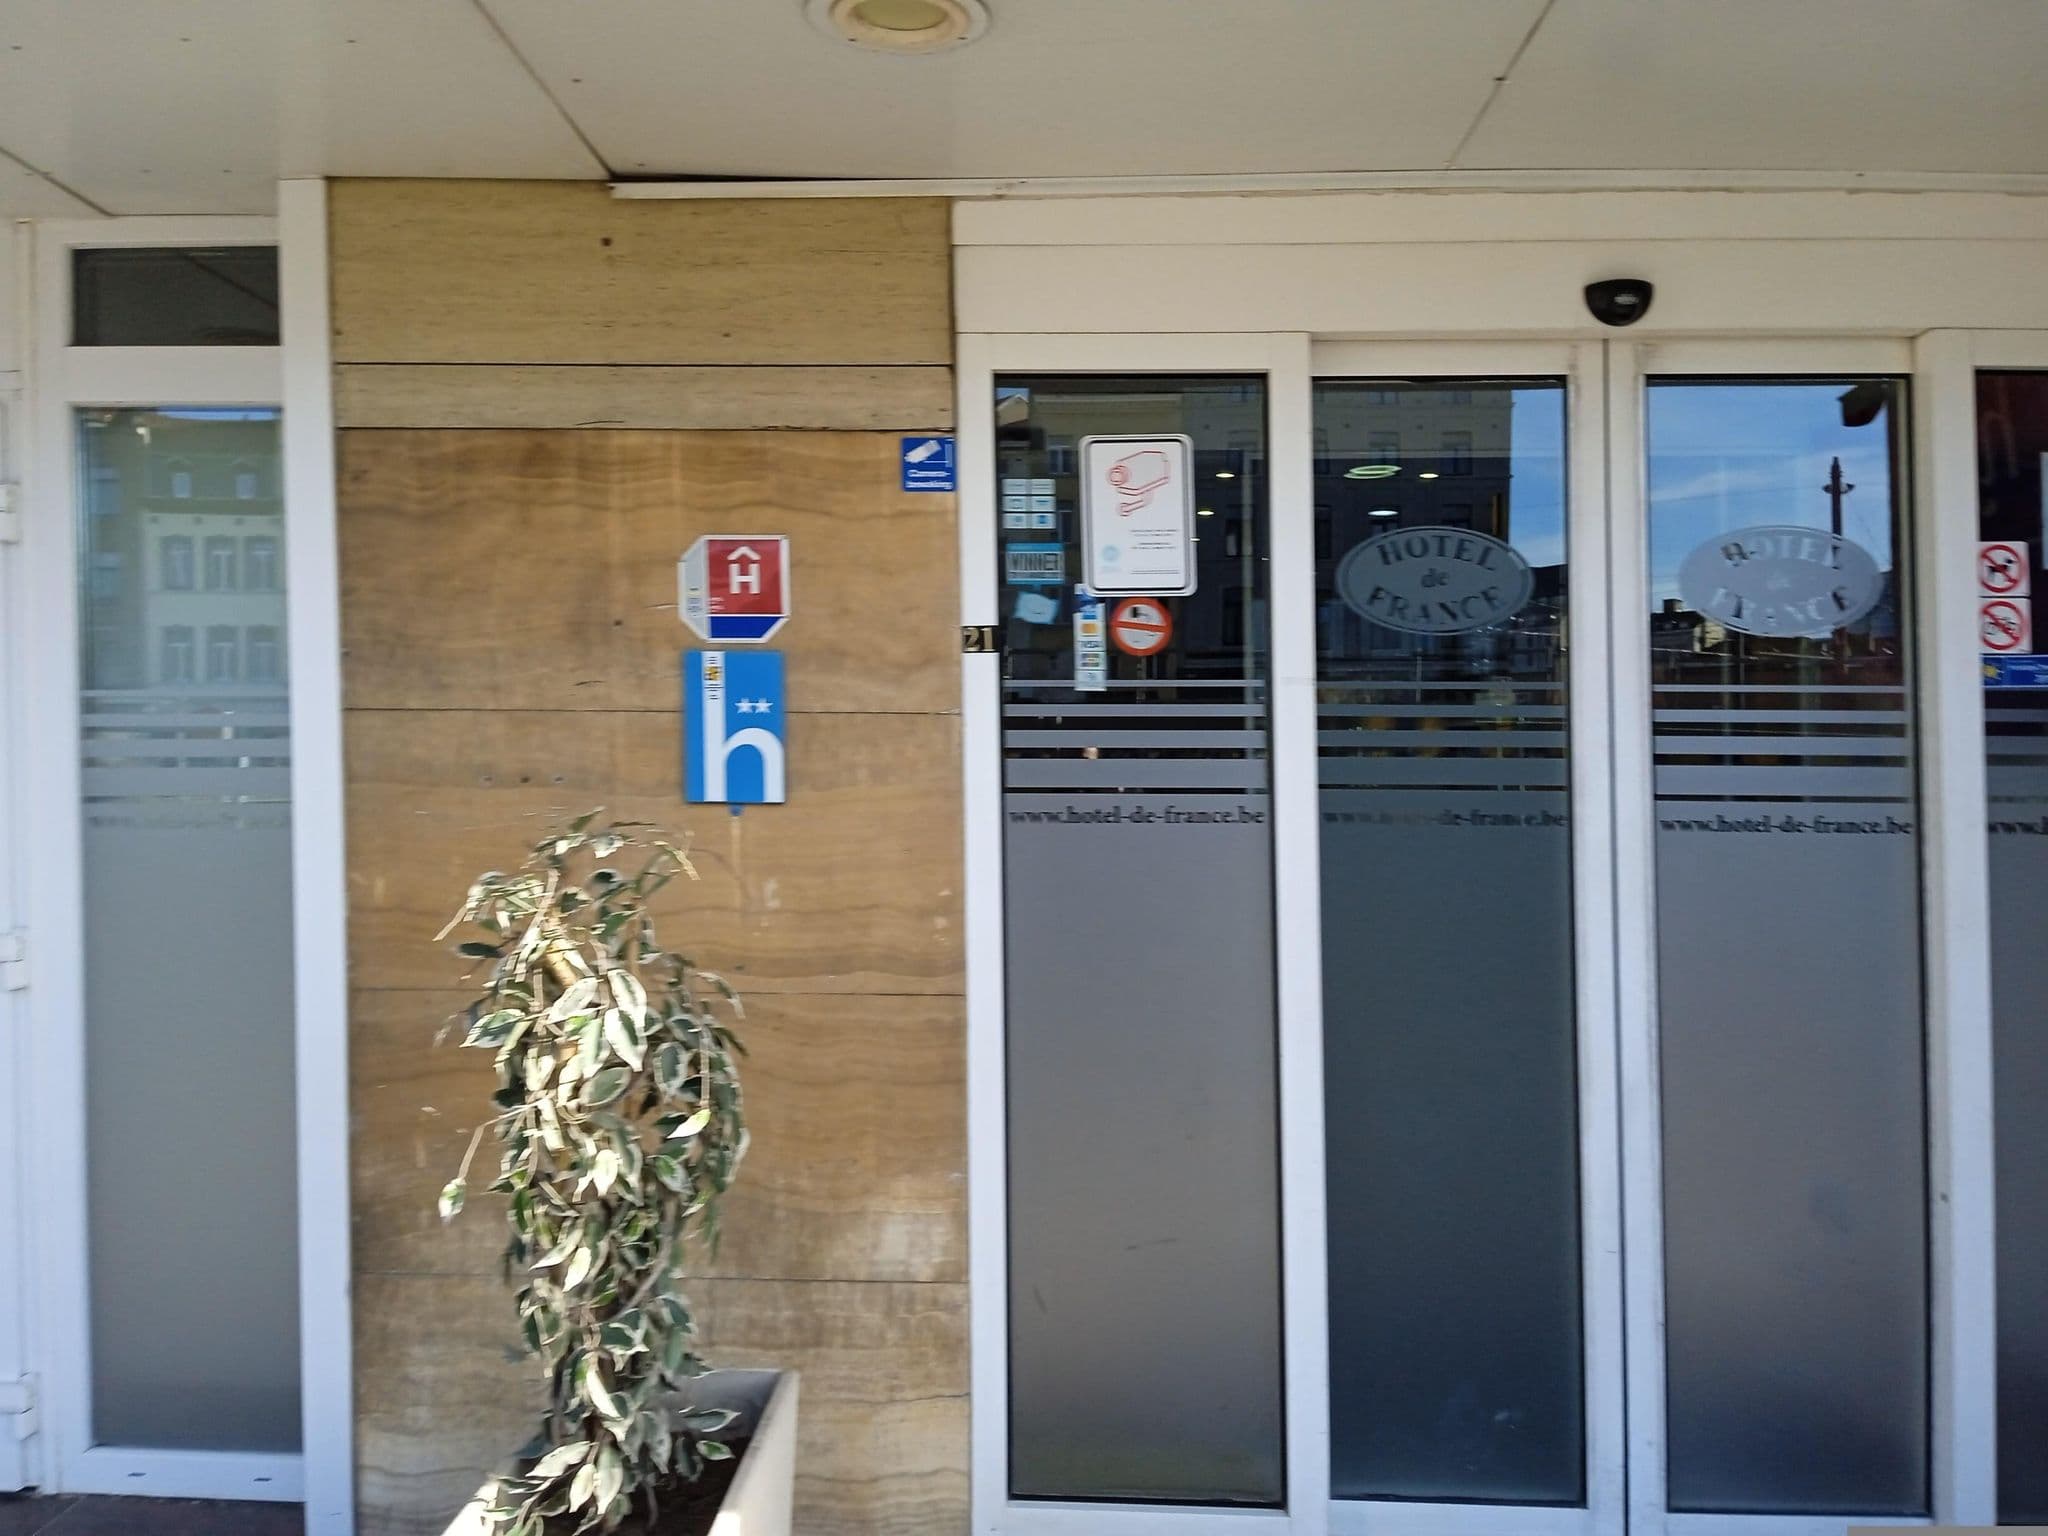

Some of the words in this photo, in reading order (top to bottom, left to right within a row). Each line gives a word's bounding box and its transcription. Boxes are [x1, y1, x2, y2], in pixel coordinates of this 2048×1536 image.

[1376, 534, 1496, 571] HOTEL
[729, 563, 761, 595] H
[1421, 568, 1449, 588] de
[1367, 586, 1502, 625] FRANCE
[962, 627, 995, 651] 21
[1009, 804, 1265, 825] www.hotel-de-france.be
[1660, 814, 1912, 835] www.hotel-de-france.be
